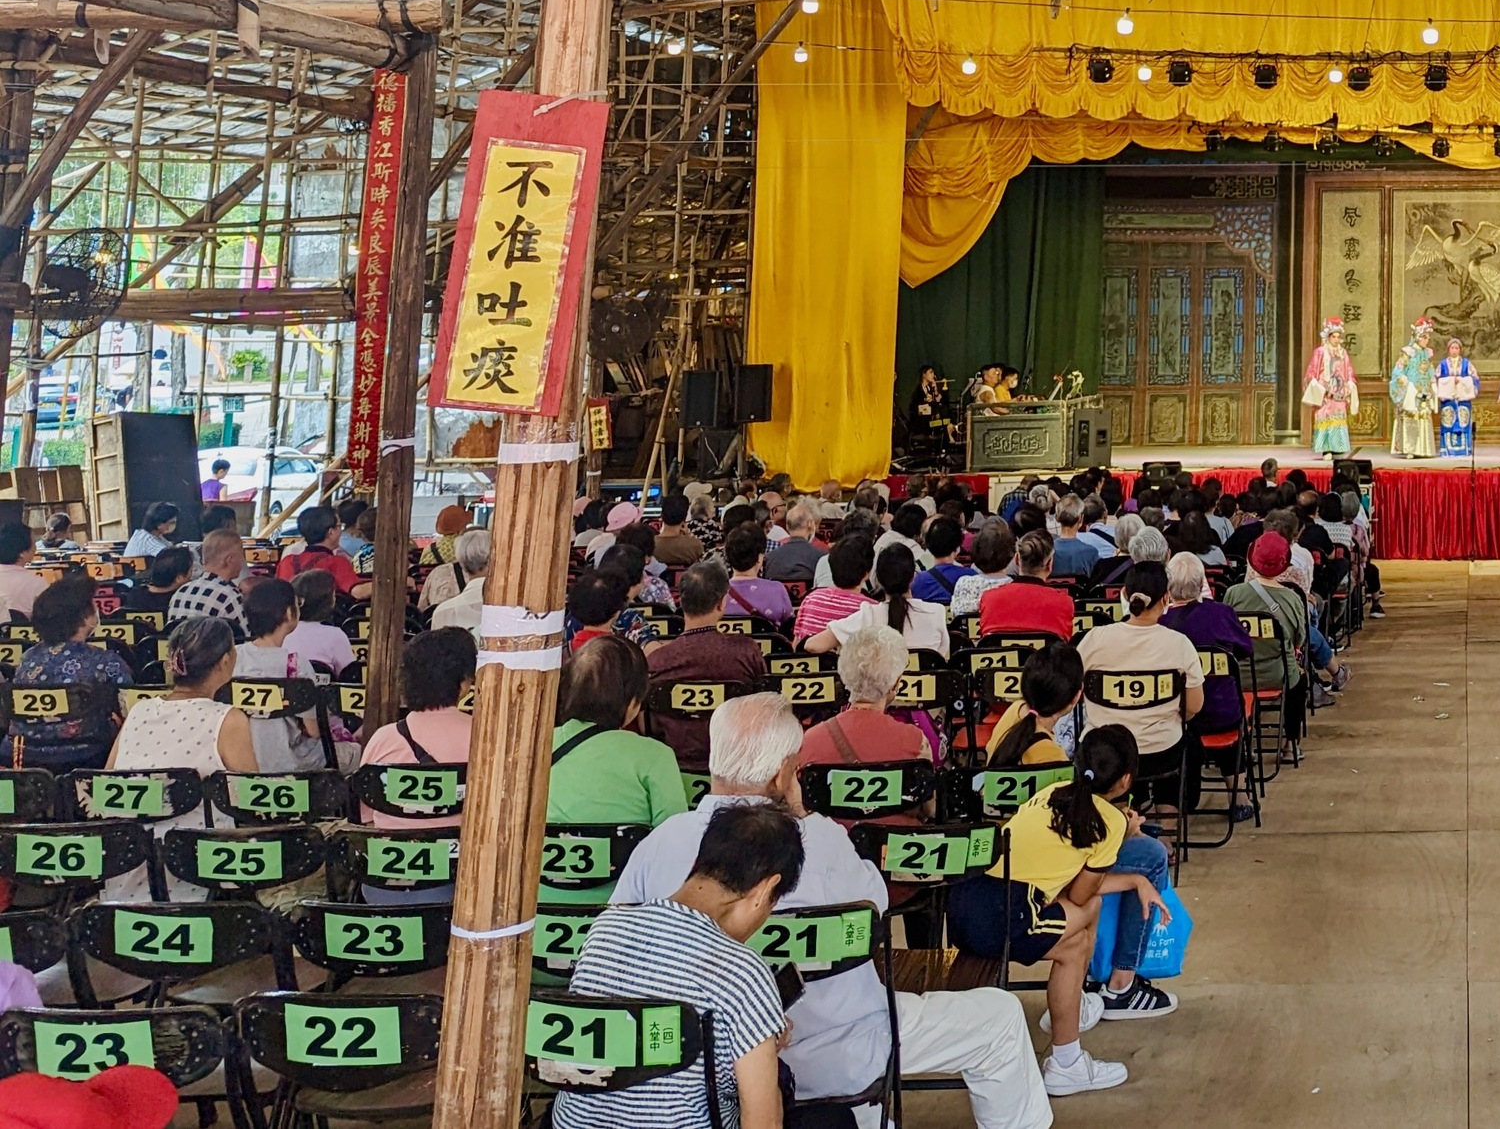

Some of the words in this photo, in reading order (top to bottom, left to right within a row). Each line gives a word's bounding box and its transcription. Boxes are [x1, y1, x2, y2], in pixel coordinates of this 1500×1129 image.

[462, 160, 553, 394] 不准吐痰
[22, 693, 58, 712] 29
[240, 687, 273, 707] 27
[681, 688, 715, 707] 23
[791, 681, 825, 701] 22
[1113, 680, 1145, 698] 19
[104, 782, 149, 810] 27
[249, 784, 296, 808] 26
[398, 775, 443, 801] 25
[843, 777, 889, 803] 22
[996, 776, 1037, 801] 21
[31, 841, 86, 871] 26
[211, 847, 266, 876] 25
[381, 845, 435, 876] 24
[543, 843, 595, 873] 23
[899, 841, 949, 870] 21
[131, 921, 194, 957] 24
[342, 923, 404, 957] 23
[762, 923, 819, 958] 21
[304, 1016, 378, 1058] 22
[541, 1013, 606, 1059] 21
[649, 1021, 660, 1052] 大堂中
[54, 1032, 130, 1073] 23
